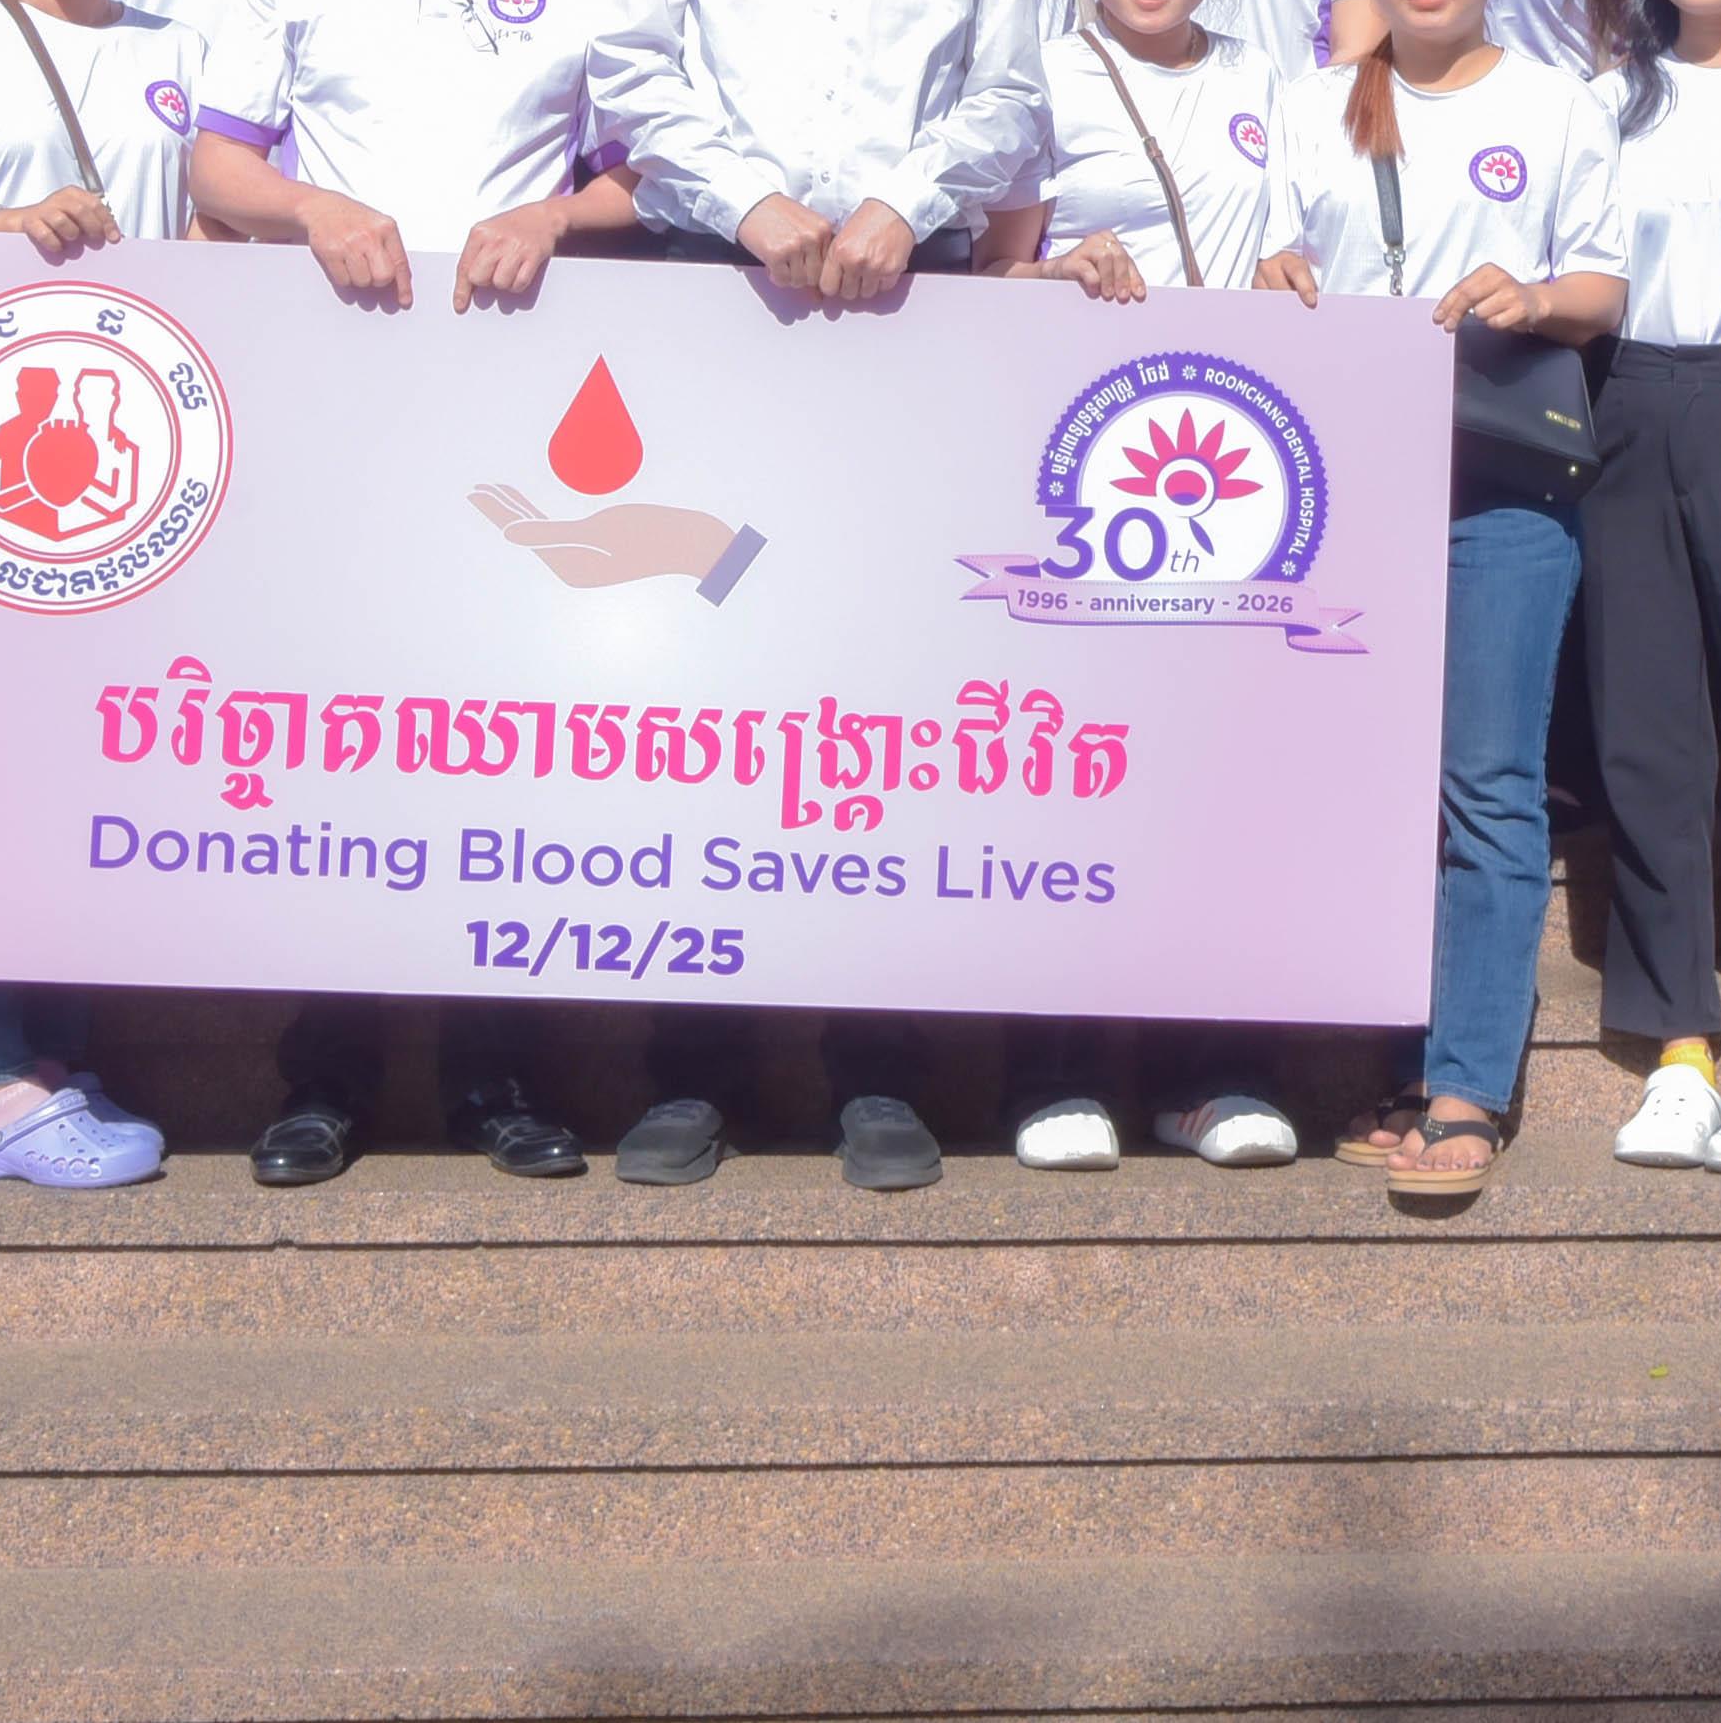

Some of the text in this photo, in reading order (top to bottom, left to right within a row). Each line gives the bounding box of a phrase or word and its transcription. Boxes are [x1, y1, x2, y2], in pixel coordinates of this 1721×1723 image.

[1204, 367, 1315, 556] ROOMCHANG DENTAL HOSPITAL
[1016, 589, 1069, 612] 1996
[1089, 593, 1215, 616] anniversary
[1236, 593, 1294, 614] 2026
[94, 655, 1131, 832] បរិច្ចាគឈាមសង្គ្រោះជីវិត
[88, 814, 1116, 905] Donating Blood Saves Lives
[466, 916, 745, 979] 12/12/25
